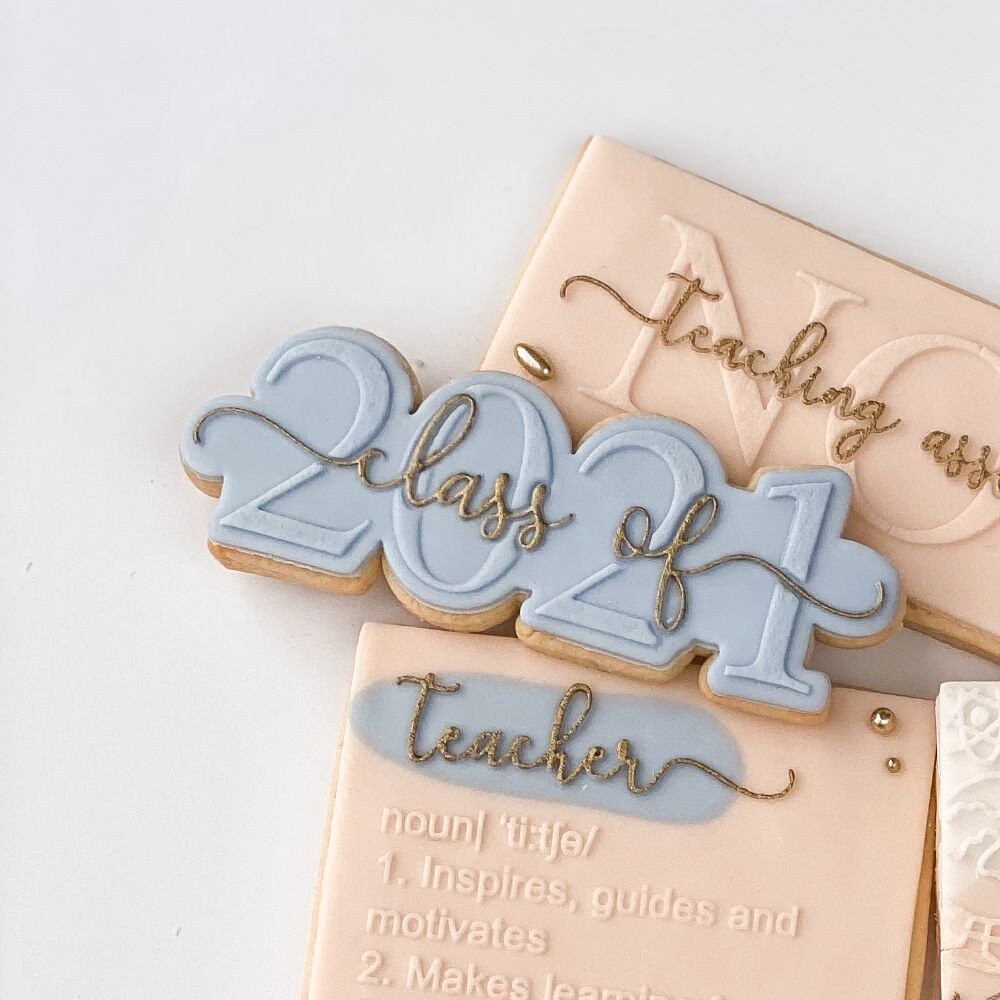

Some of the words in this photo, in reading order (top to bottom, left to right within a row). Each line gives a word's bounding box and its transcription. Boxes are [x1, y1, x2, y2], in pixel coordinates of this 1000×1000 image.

[560, 272, 901, 463] teaching
[194, 393, 576, 551] class
[613, 493, 886, 633] of
[217, 336, 832, 695] 2021
[395, 671, 796, 802] teacher
[365, 905, 550, 955] motivates
[378, 850, 407, 887] 1.
[420, 855, 578, 913] Inspires,
[591, 884, 716, 926] guides
[727, 903, 801, 938] and
[357, 950, 391, 987] 2.
